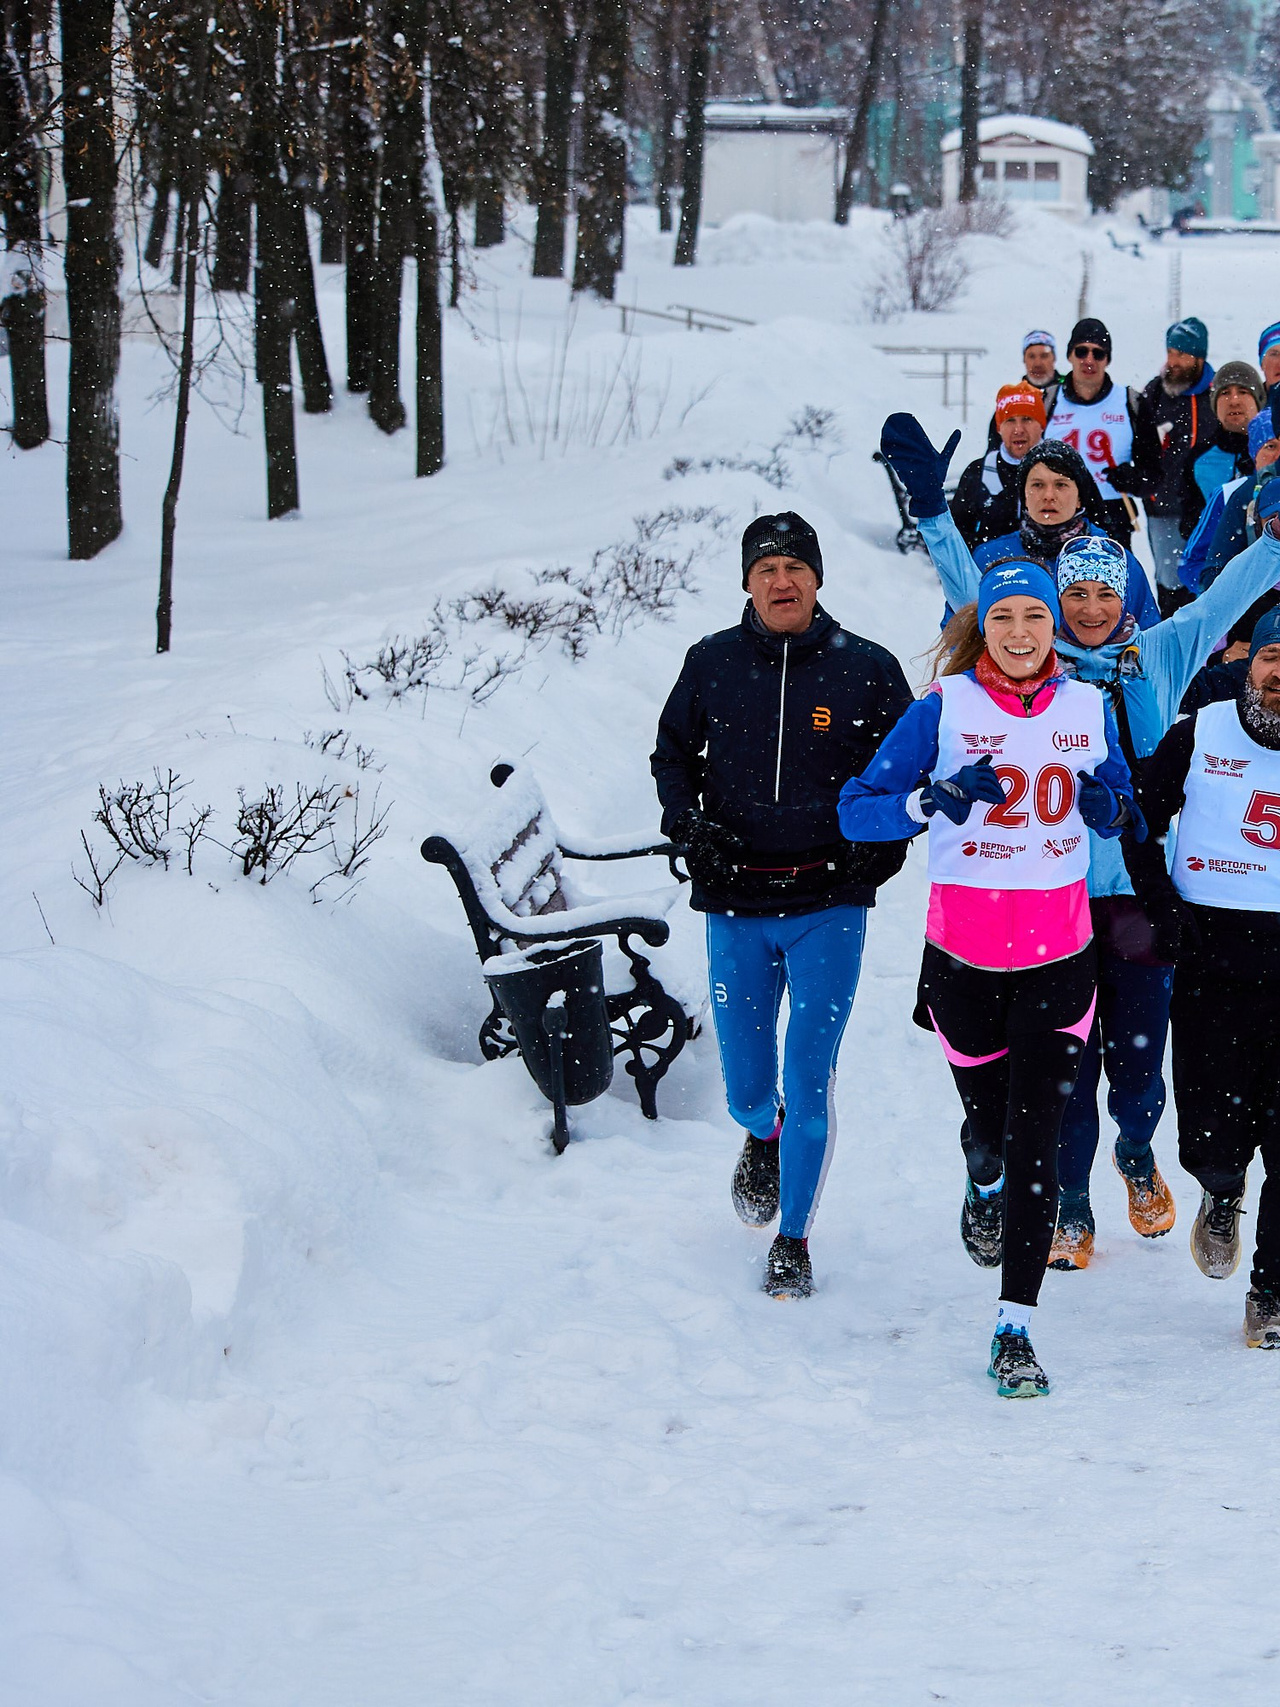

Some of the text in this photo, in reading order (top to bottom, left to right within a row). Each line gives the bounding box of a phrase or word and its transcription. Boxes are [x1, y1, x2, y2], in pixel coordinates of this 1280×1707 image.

[1061, 428, 1112, 464] 19
[1058, 734, 1089, 748] НЦВ
[983, 762, 1076, 829] 20
[979, 850, 1011, 860] РОССИИ
[980, 842, 1027, 854] ВЕРТОЛЕТЫ
[1208, 858, 1267, 872] ВЕРТОЛЕТЫ
[1209, 865, 1248, 876] РОССИИ
